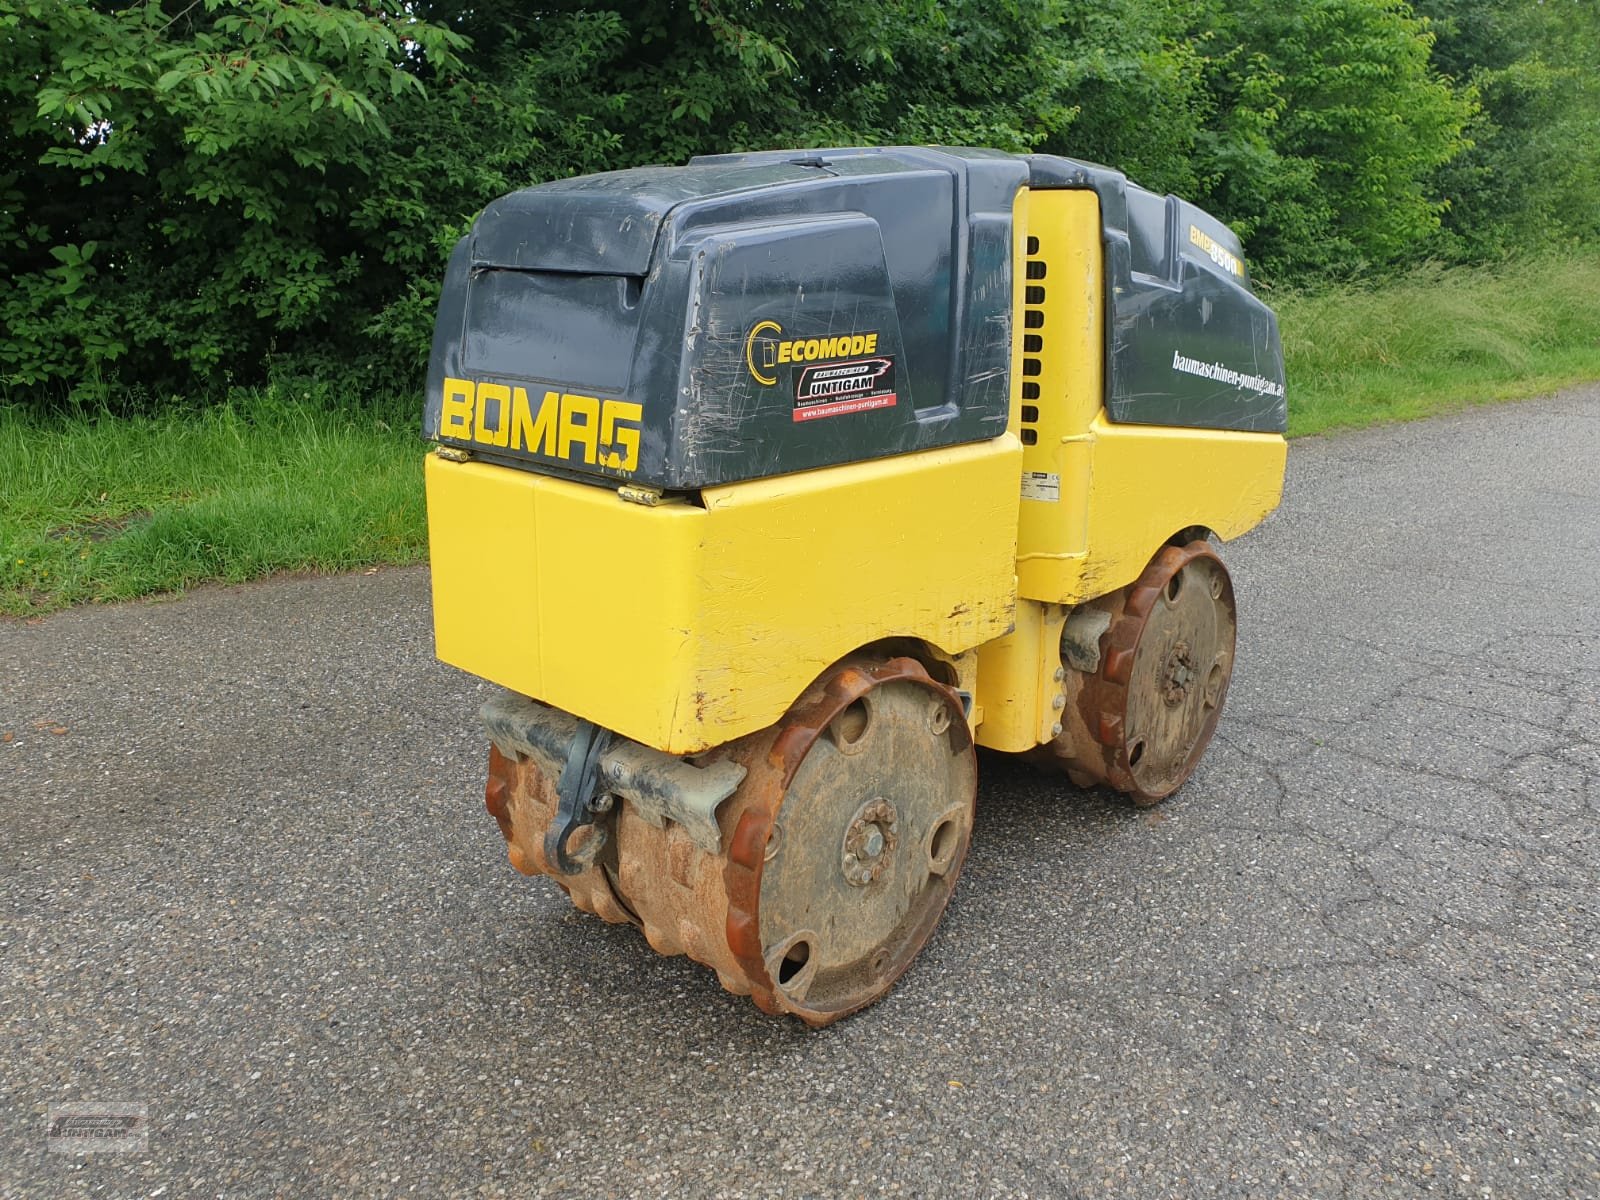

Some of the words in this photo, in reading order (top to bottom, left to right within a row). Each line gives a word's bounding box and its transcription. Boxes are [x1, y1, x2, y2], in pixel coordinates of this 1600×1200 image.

[777, 333, 878, 363] ECOMODE
[802, 398, 889, 418] www.baumaschinen-puntigam.at
[440, 377, 643, 472] BOMAG
